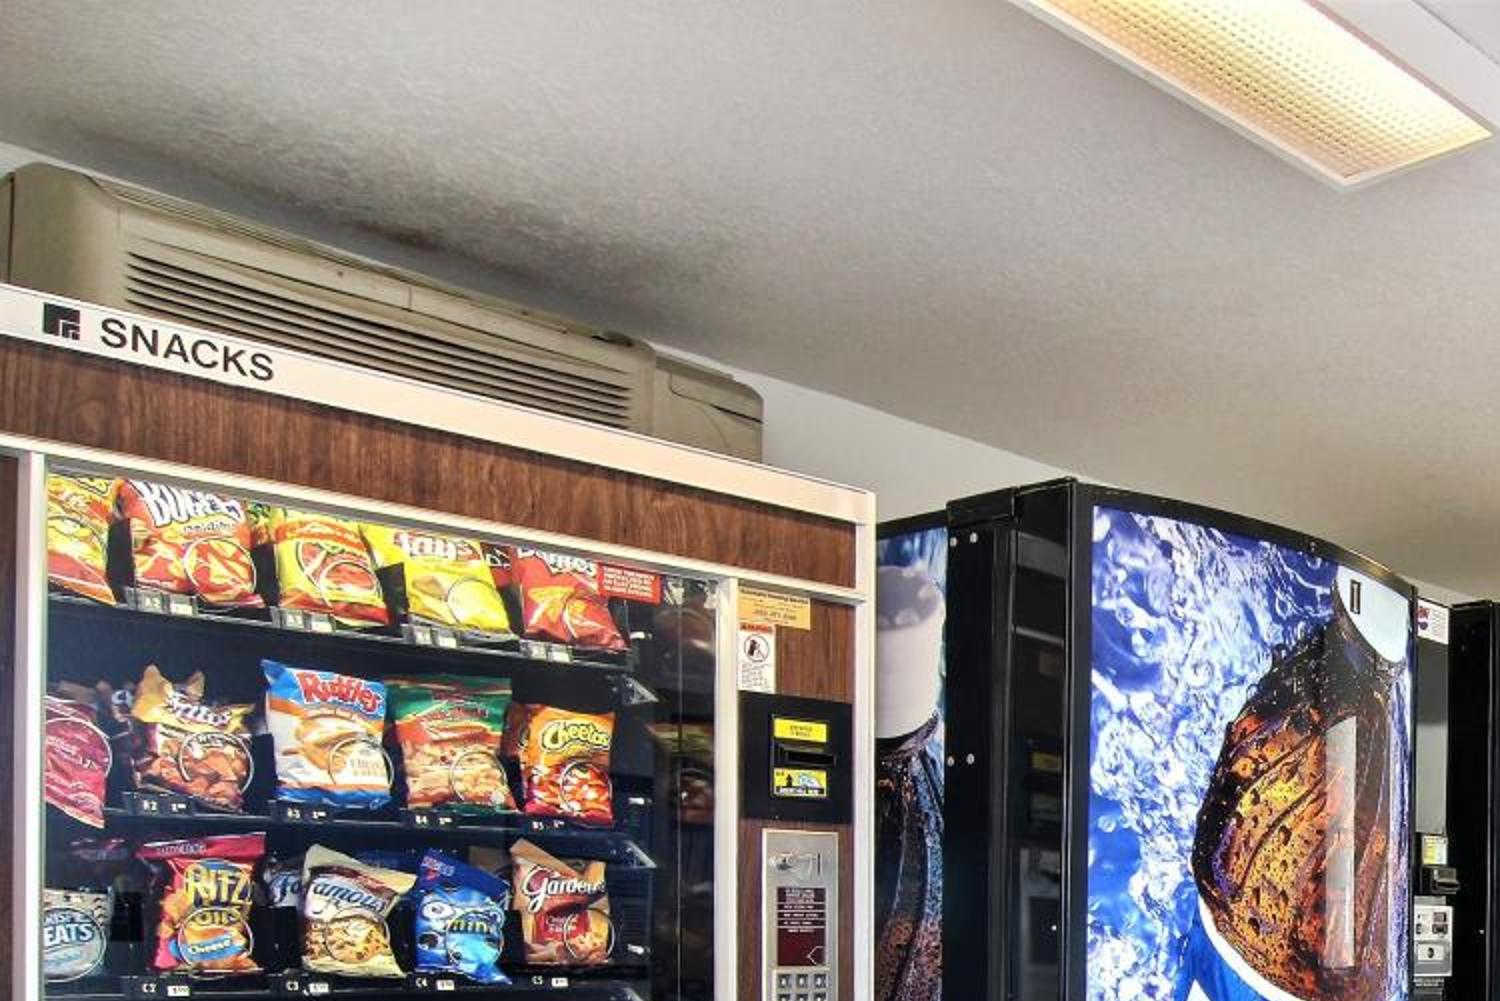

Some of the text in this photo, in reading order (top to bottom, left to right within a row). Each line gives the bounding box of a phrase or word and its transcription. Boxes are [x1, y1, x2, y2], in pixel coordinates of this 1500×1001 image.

[100, 317, 275, 382] SNACKS
[541, 720, 612, 751] Cheetos
[184, 862, 253, 909] RITZ
[43, 922, 95, 946] EATS
